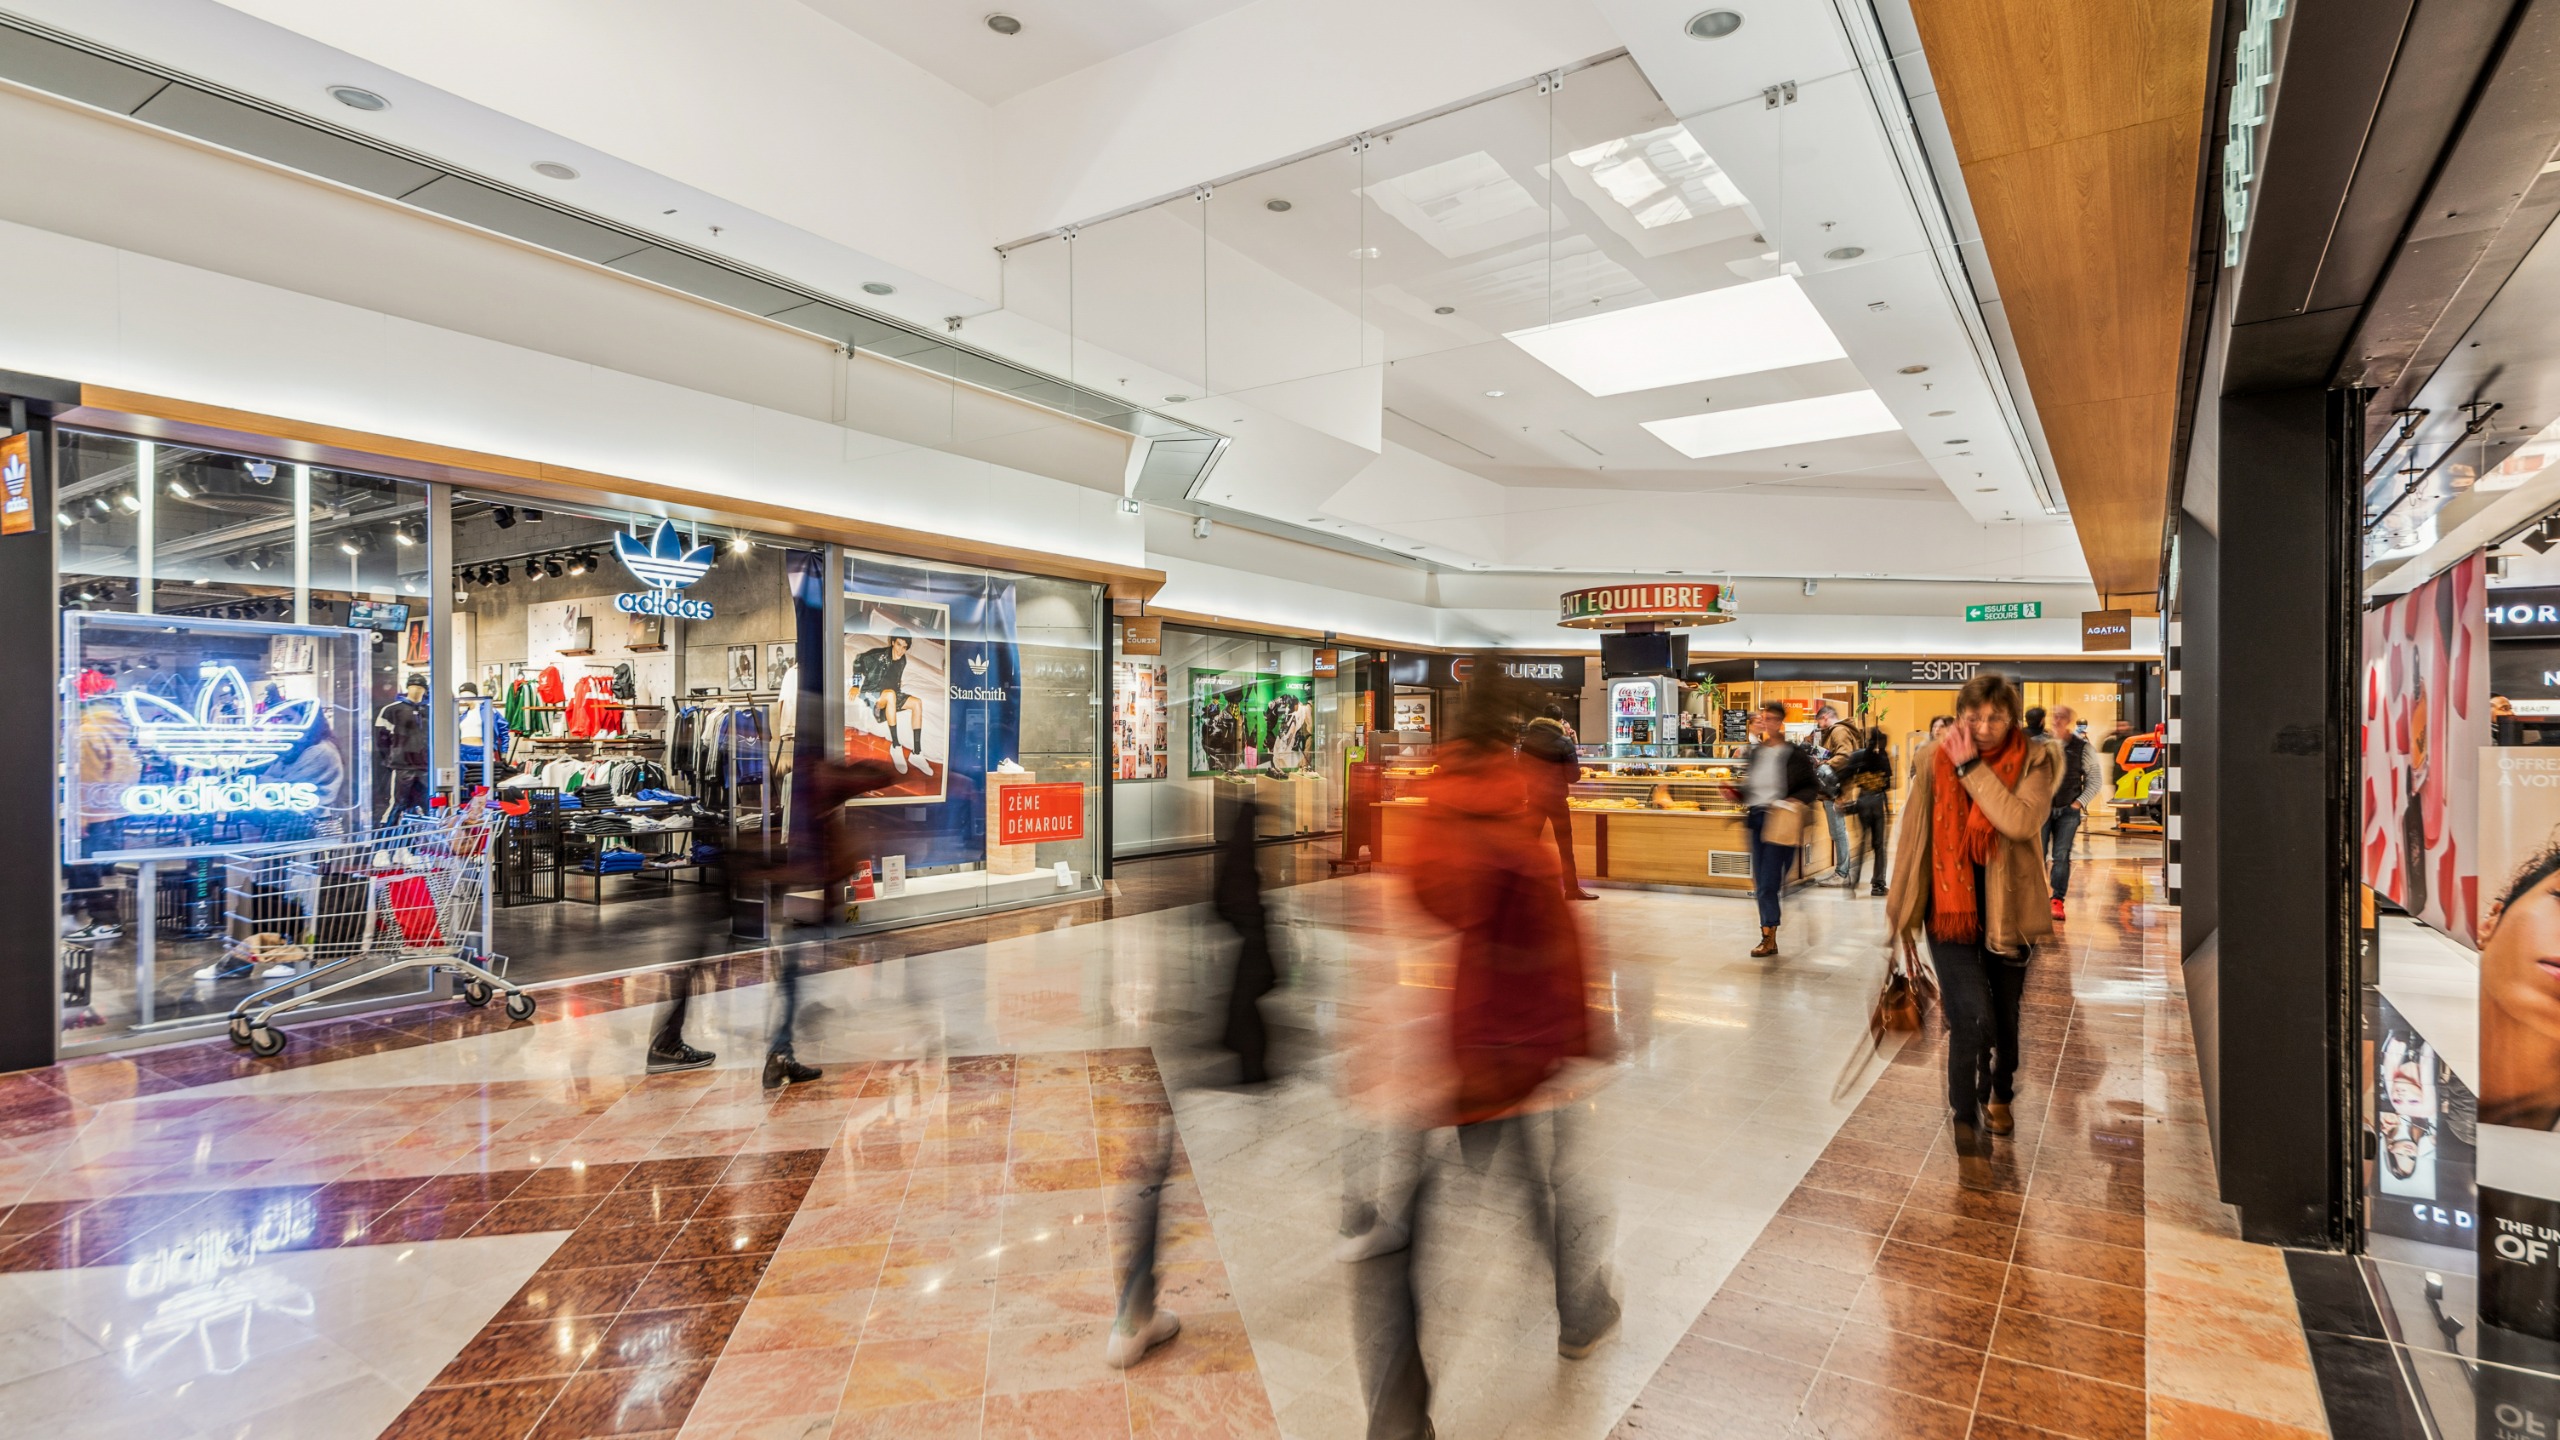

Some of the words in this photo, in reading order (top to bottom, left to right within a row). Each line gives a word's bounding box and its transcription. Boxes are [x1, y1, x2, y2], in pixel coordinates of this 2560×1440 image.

[614, 590, 715, 620] adidas
[1588, 586, 1703, 612] EQUILIBRE
[1984, 604, 2006, 613] ISSUE
[2008, 604, 2018, 612] DE
[1984, 611, 2018, 620] SECOURS
[2087, 625, 2126, 635] AGATHA
[1912, 661, 1980, 681] ESPRIT
[950, 685, 974, 700] Stan
[974, 686, 1006, 701] Smith
[2498, 758, 2560, 770] OFFRE
[121, 774, 320, 815] adidas
[1008, 792, 1040, 811] 2ÈME
[1008, 815, 1073, 834] DÉMARQUE
[2495, 1216, 2534, 1237] THE
[2494, 1233, 2549, 1266] OF
